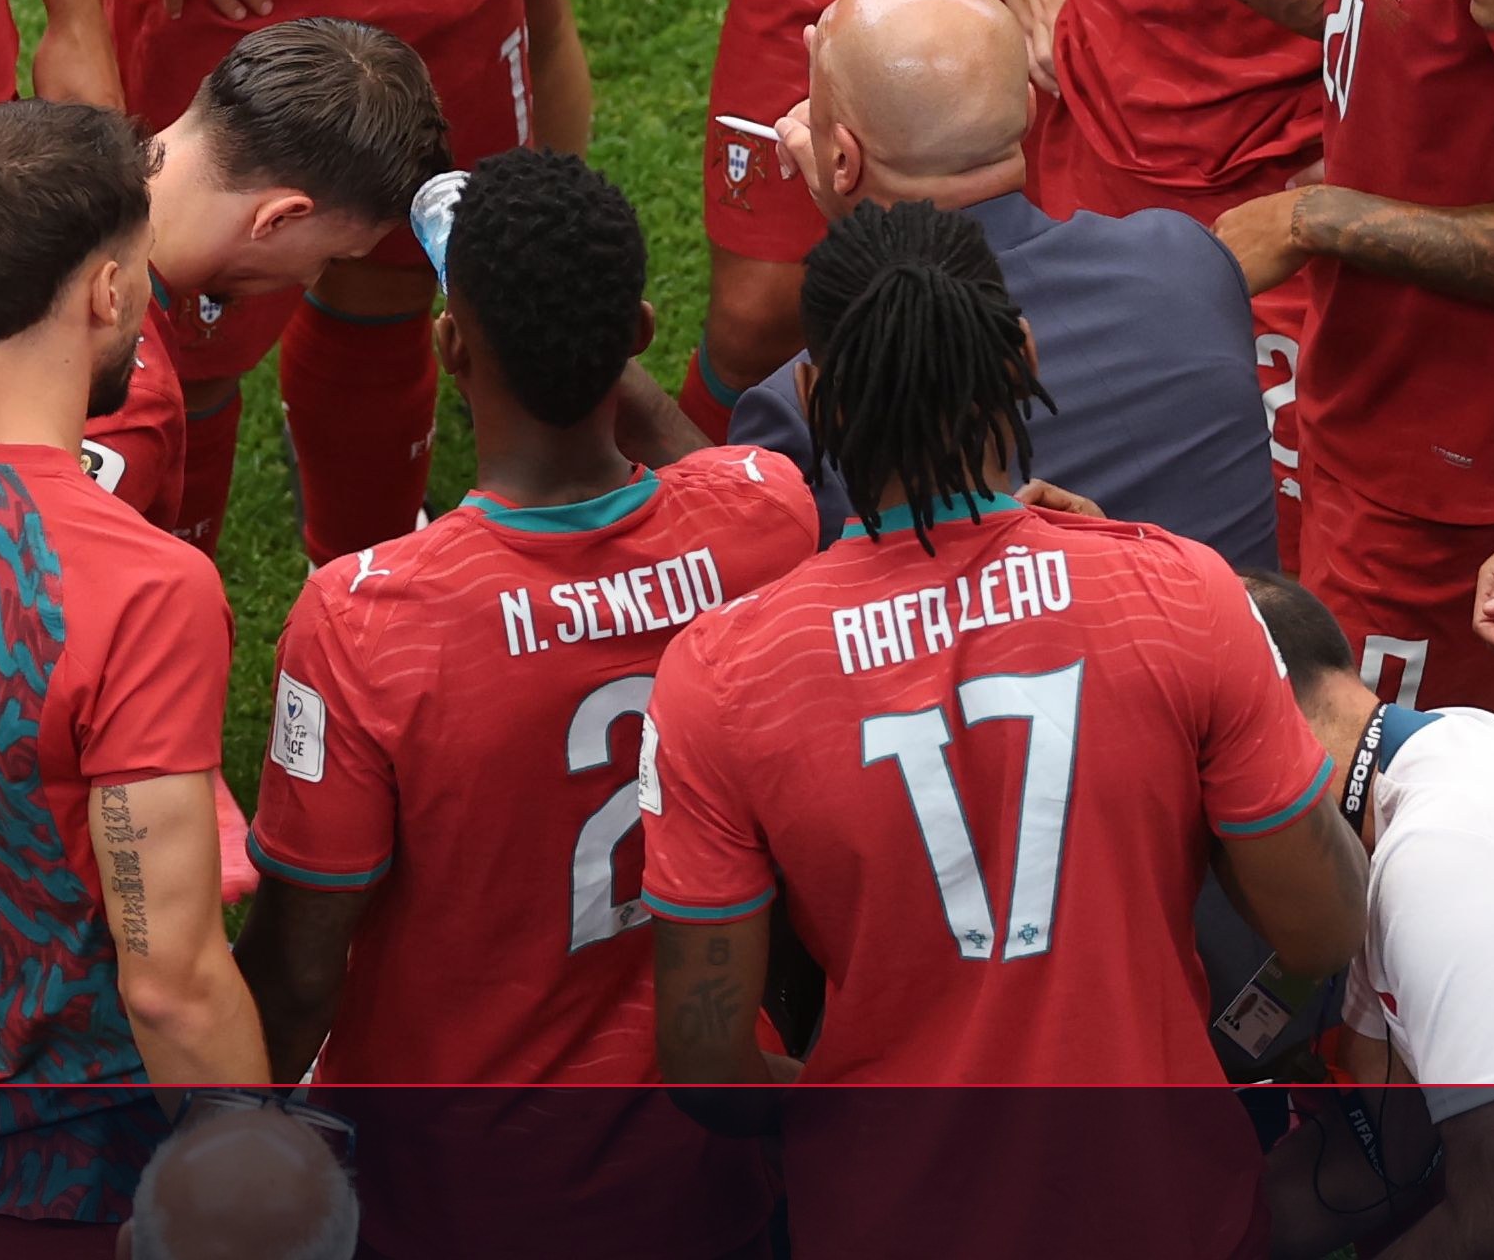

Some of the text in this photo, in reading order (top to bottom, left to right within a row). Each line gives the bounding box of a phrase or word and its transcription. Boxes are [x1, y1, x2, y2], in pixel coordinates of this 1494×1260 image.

[499, 546, 724, 656] N. SEMEDO
[832, 544, 1072, 675] RAFA LEÃO
[567, 672, 656, 954] 2
[860, 658, 1085, 964] 17
[1345, 748, 1374, 813] 2026
[1348, 1107, 1375, 1146] FIFA
